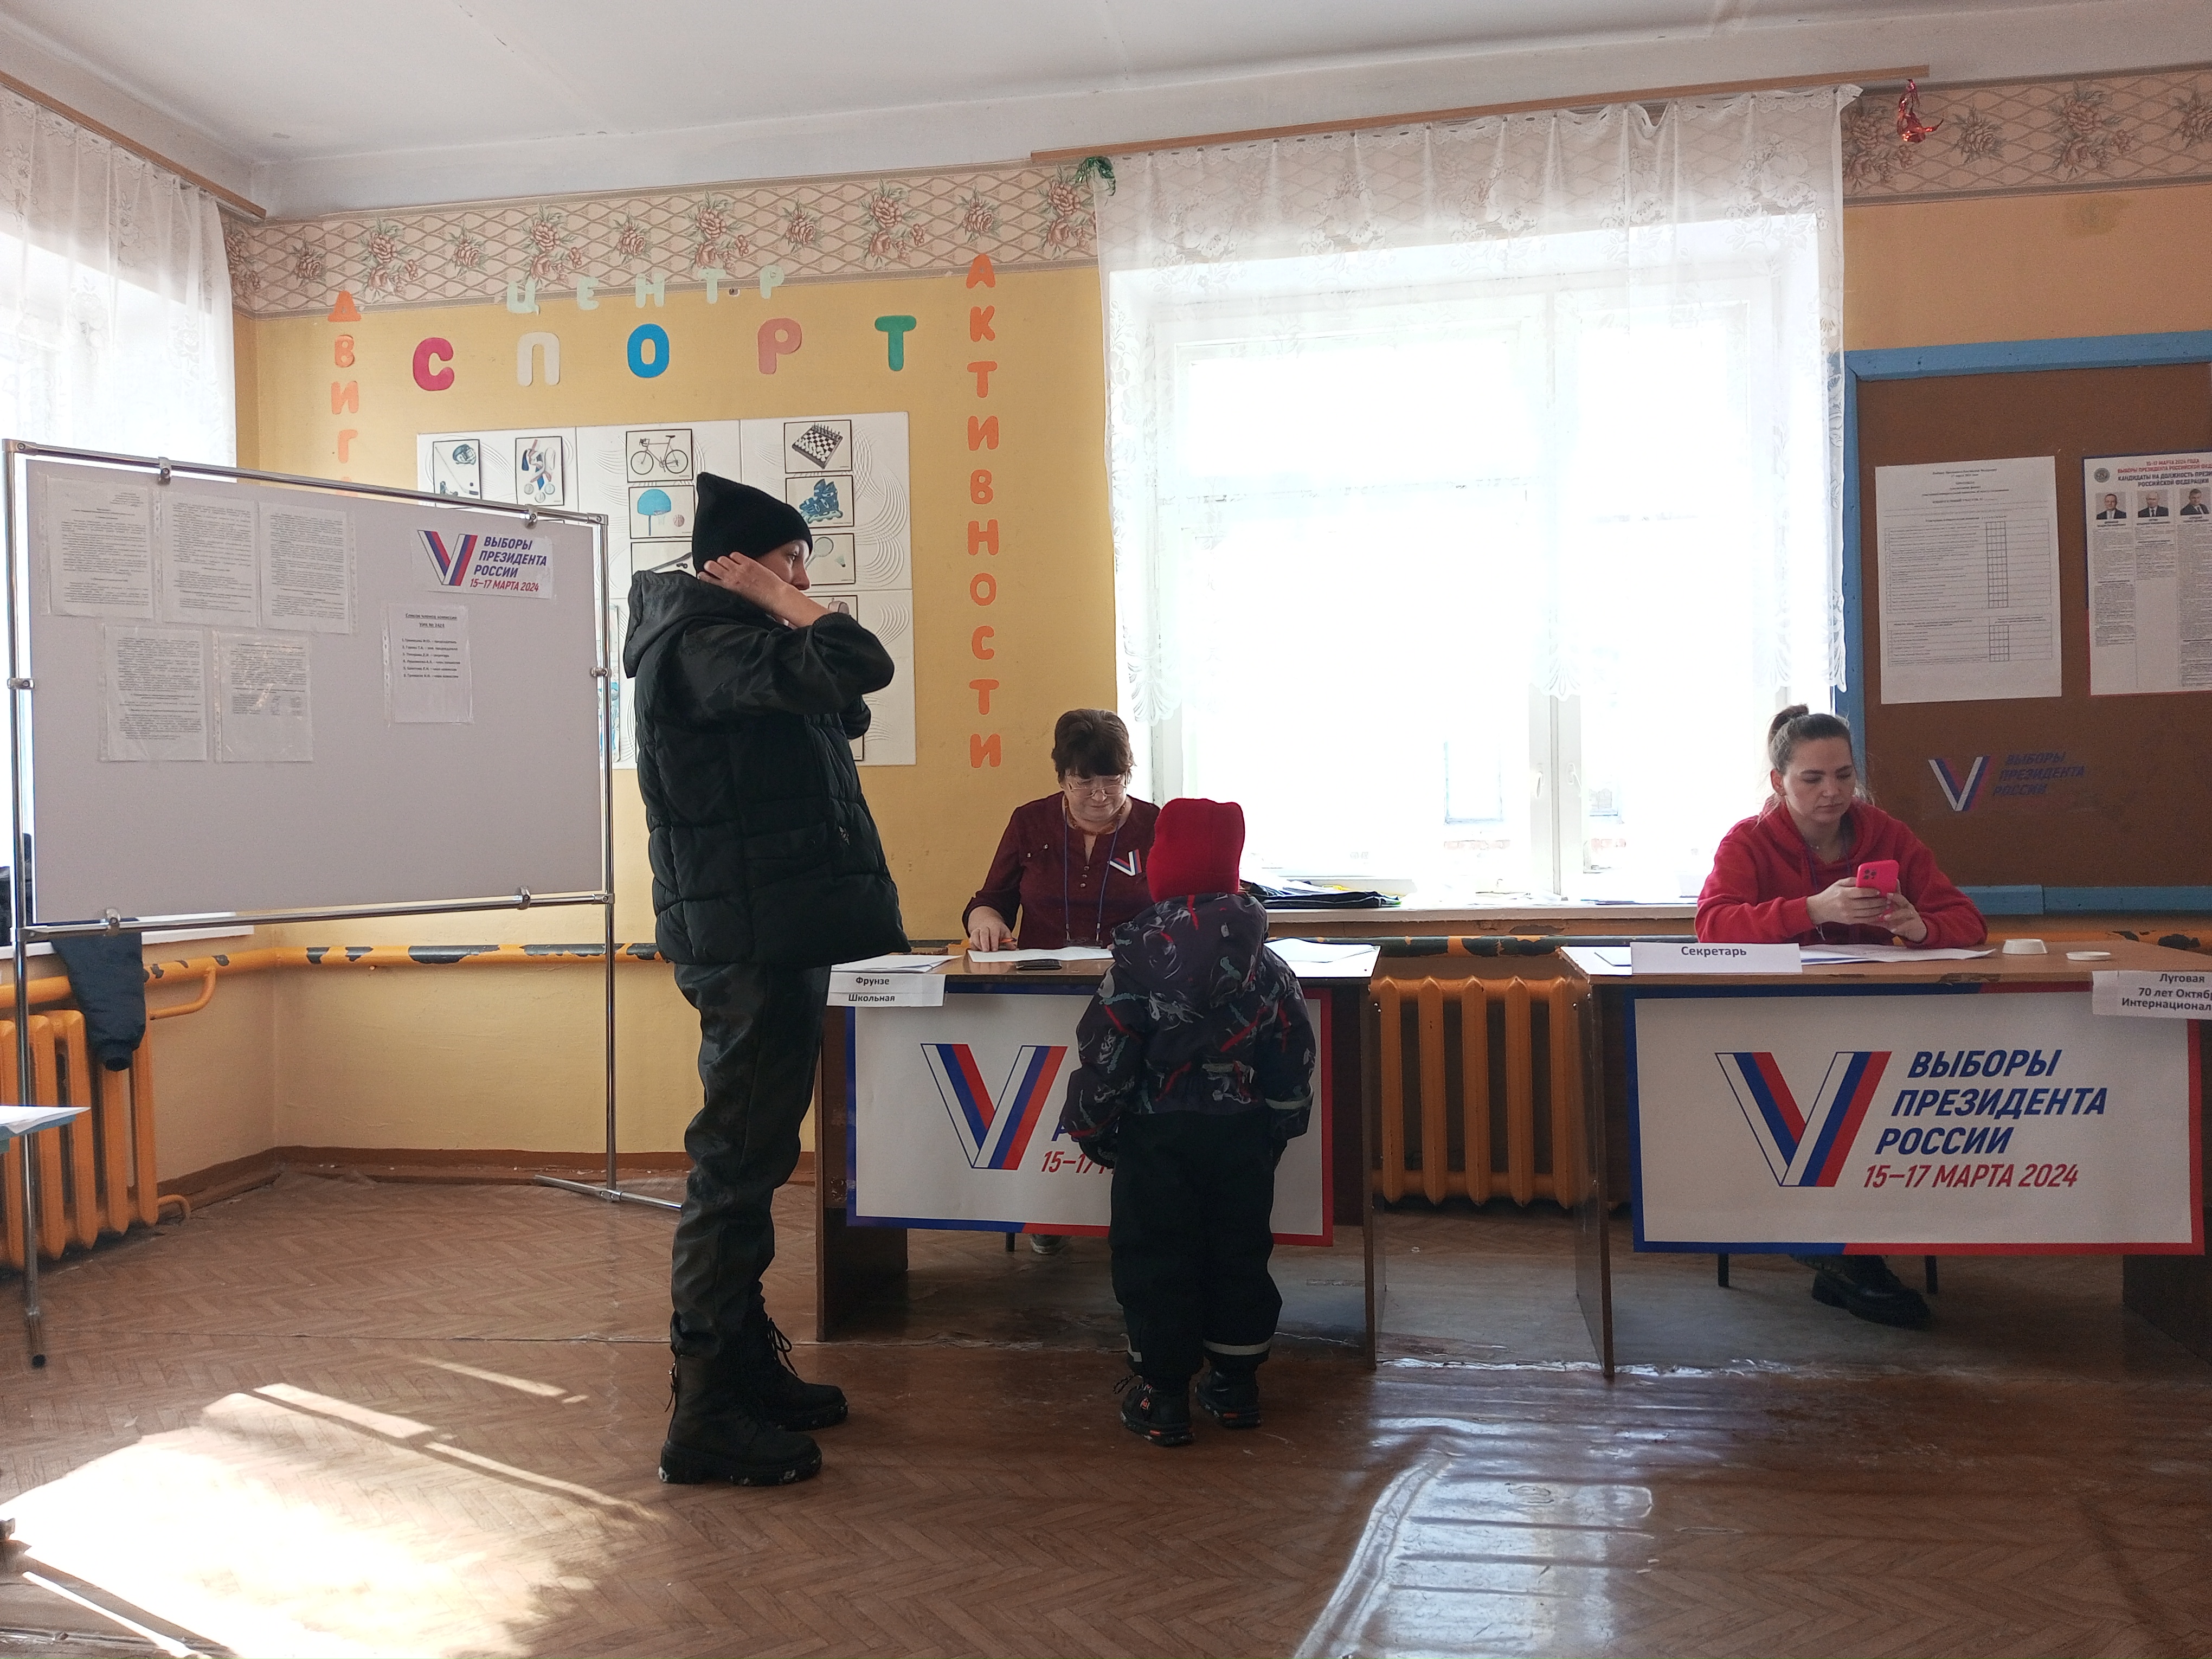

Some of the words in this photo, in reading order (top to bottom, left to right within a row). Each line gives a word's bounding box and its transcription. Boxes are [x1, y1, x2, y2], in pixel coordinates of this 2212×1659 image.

[507, 265, 785, 316] ЦЕНТР
[413, 315, 917, 391] СПОРТ
[966, 254, 1001, 768] АКТИВНОСТИ
[484, 536, 532, 550] ВЫБОРЫ
[479, 550, 547, 566] ПРЕЗИДЕНТА
[474, 564, 518, 578] РОССИИ
[492, 580, 519, 590] МАРТА
[520, 582, 539, 591] 2024
[2005, 751, 2066, 765] ВЫБОРЫ
[1999, 766, 2085, 781] ПРЕЗИДЕНТА
[1992, 783, 2048, 796] РОССИИ
[1681, 946, 1747, 957] Секретарь
[856, 976, 890, 987] Фрунзе
[2159, 973, 2205, 984] Луговая
[848, 994, 895, 1002] Школьная
[2138, 988, 2151, 996] 70
[2121, 997, 2211, 1011] Интернационал
[1907, 1049, 2062, 1078] ВЫБОРЫ
[1891, 1087, 2108, 1120] ПРЕЗИДЕНТА
[1874, 1126, 2015, 1155] РОССИИ
[1932, 1163, 2015, 1188] МАРТА
[2018, 1163, 2078, 1188] 2024
